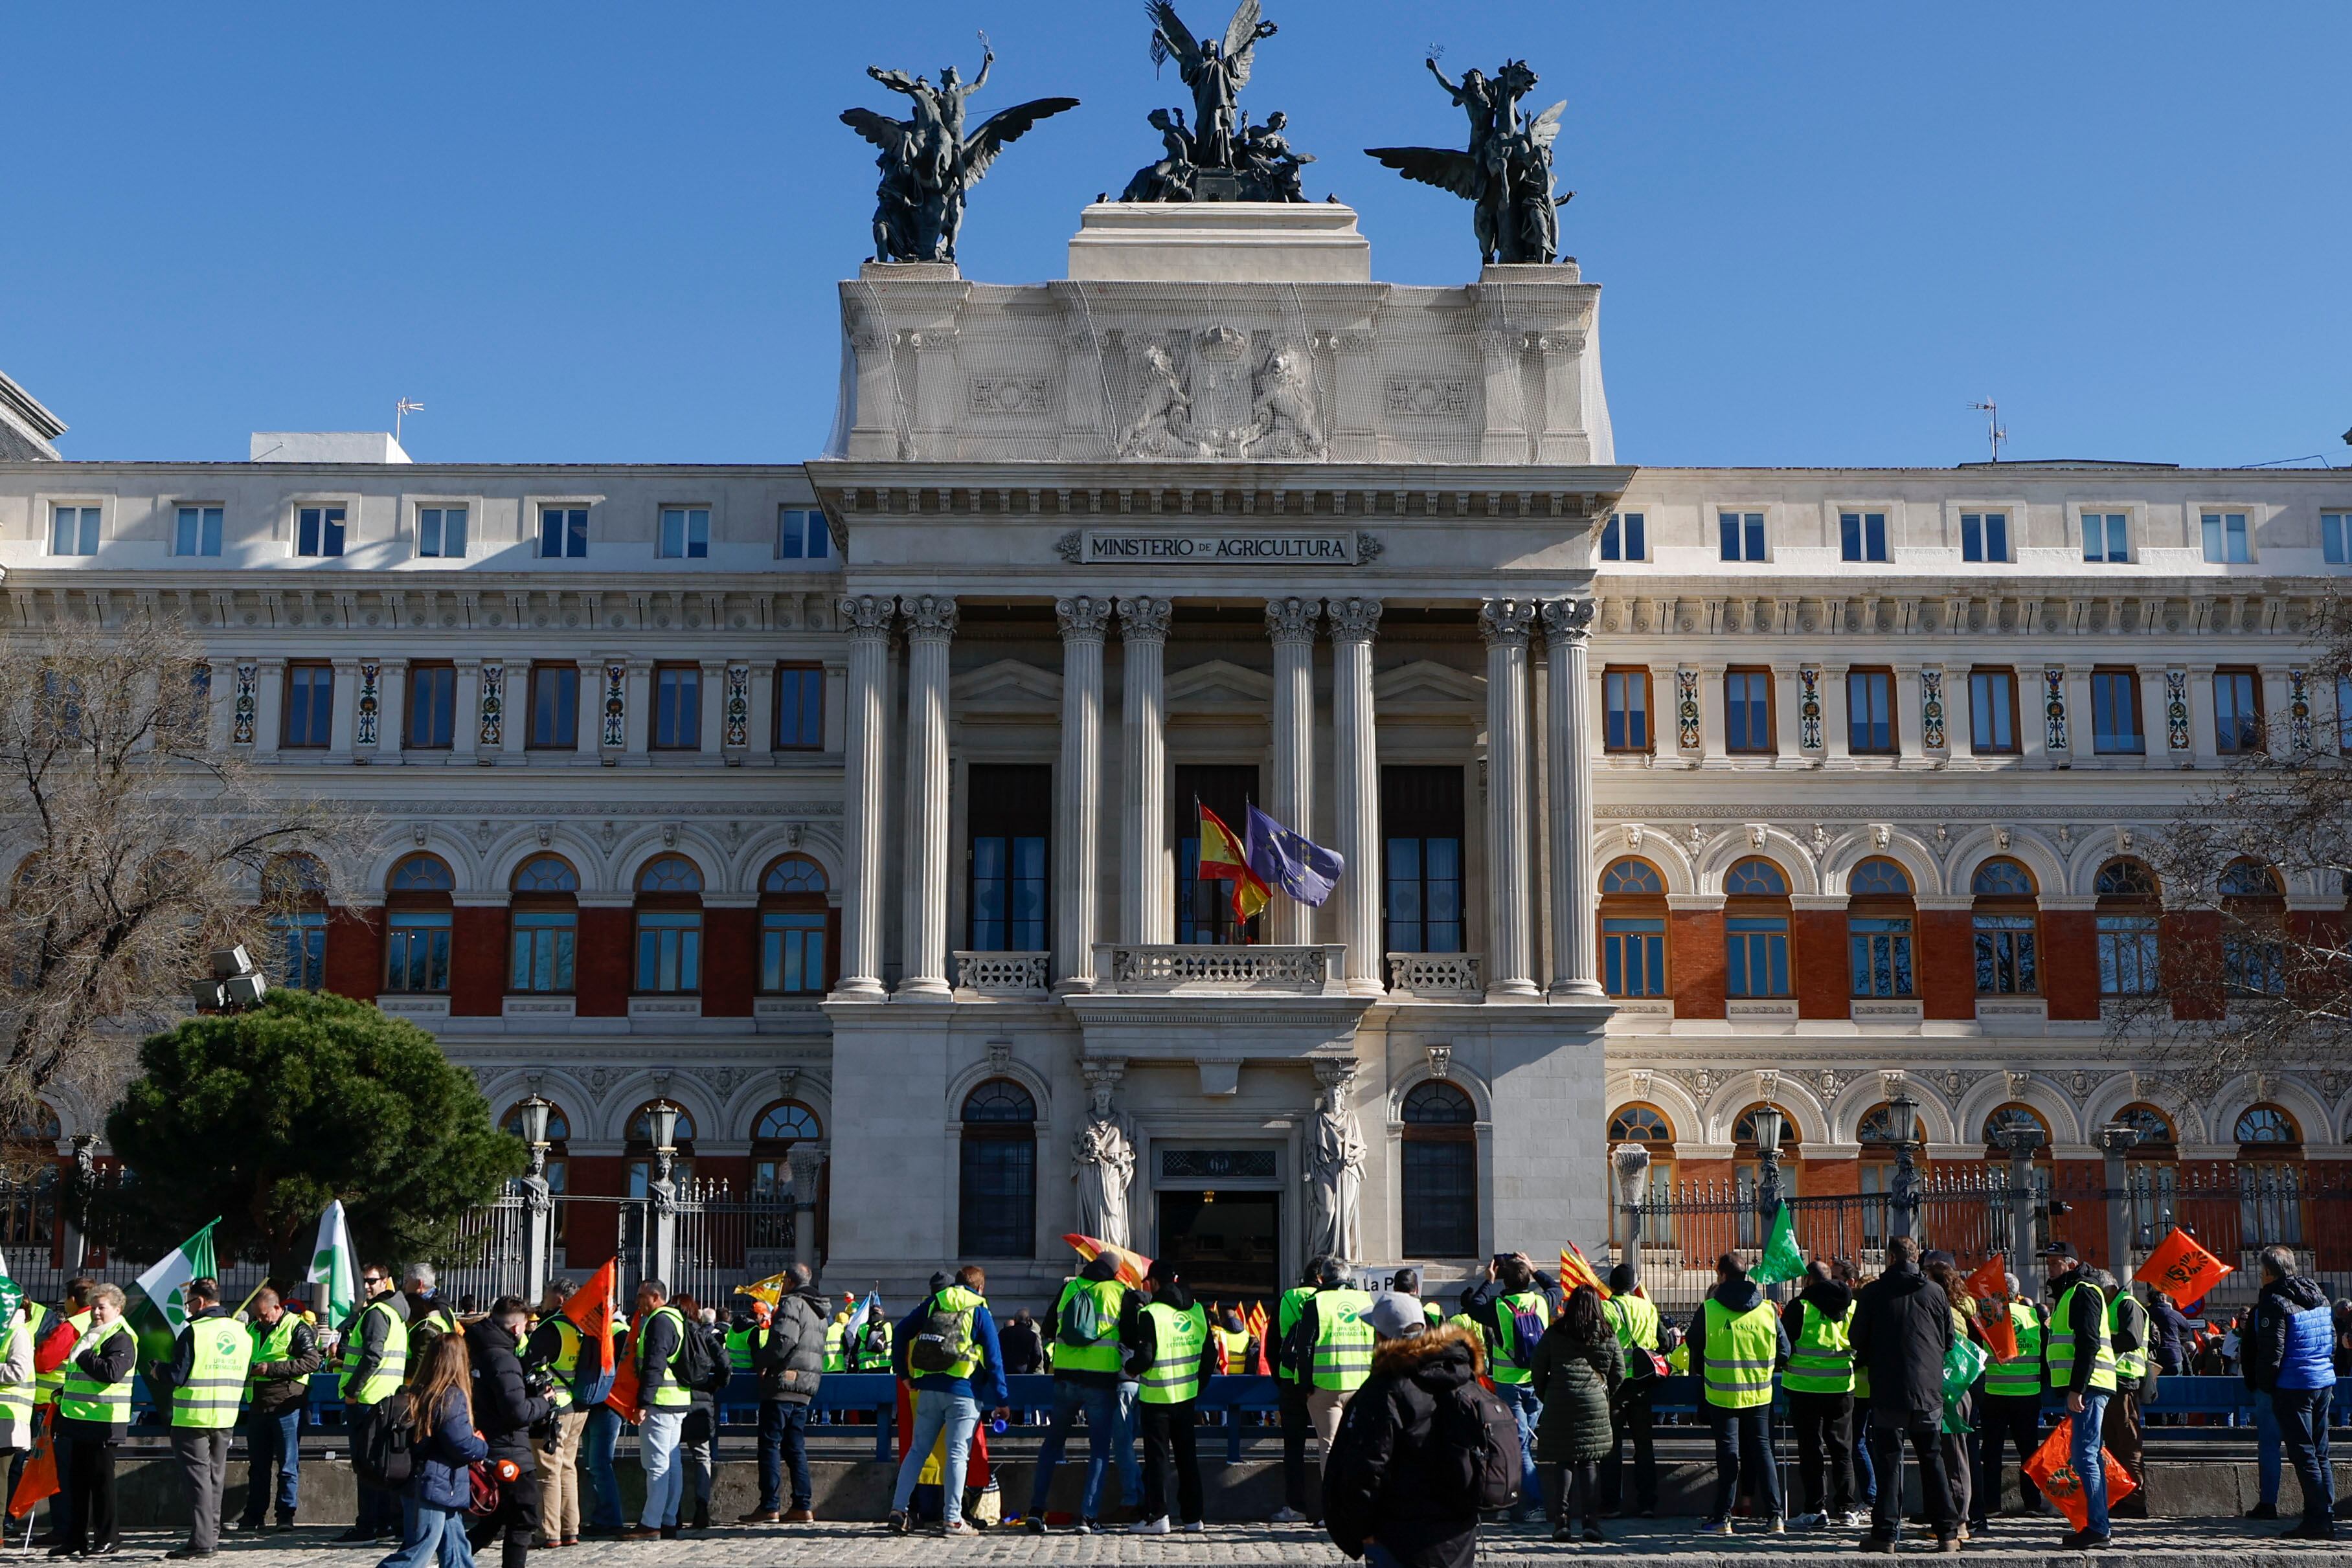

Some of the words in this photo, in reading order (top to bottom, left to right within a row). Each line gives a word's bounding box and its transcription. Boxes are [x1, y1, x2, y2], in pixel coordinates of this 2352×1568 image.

[1092, 539, 1193, 555] MINISTERIO
[1199, 543, 1212, 552] DE
[1216, 539, 1346, 557] AGRICULTURA
[1363, 1277, 1378, 1292] La
